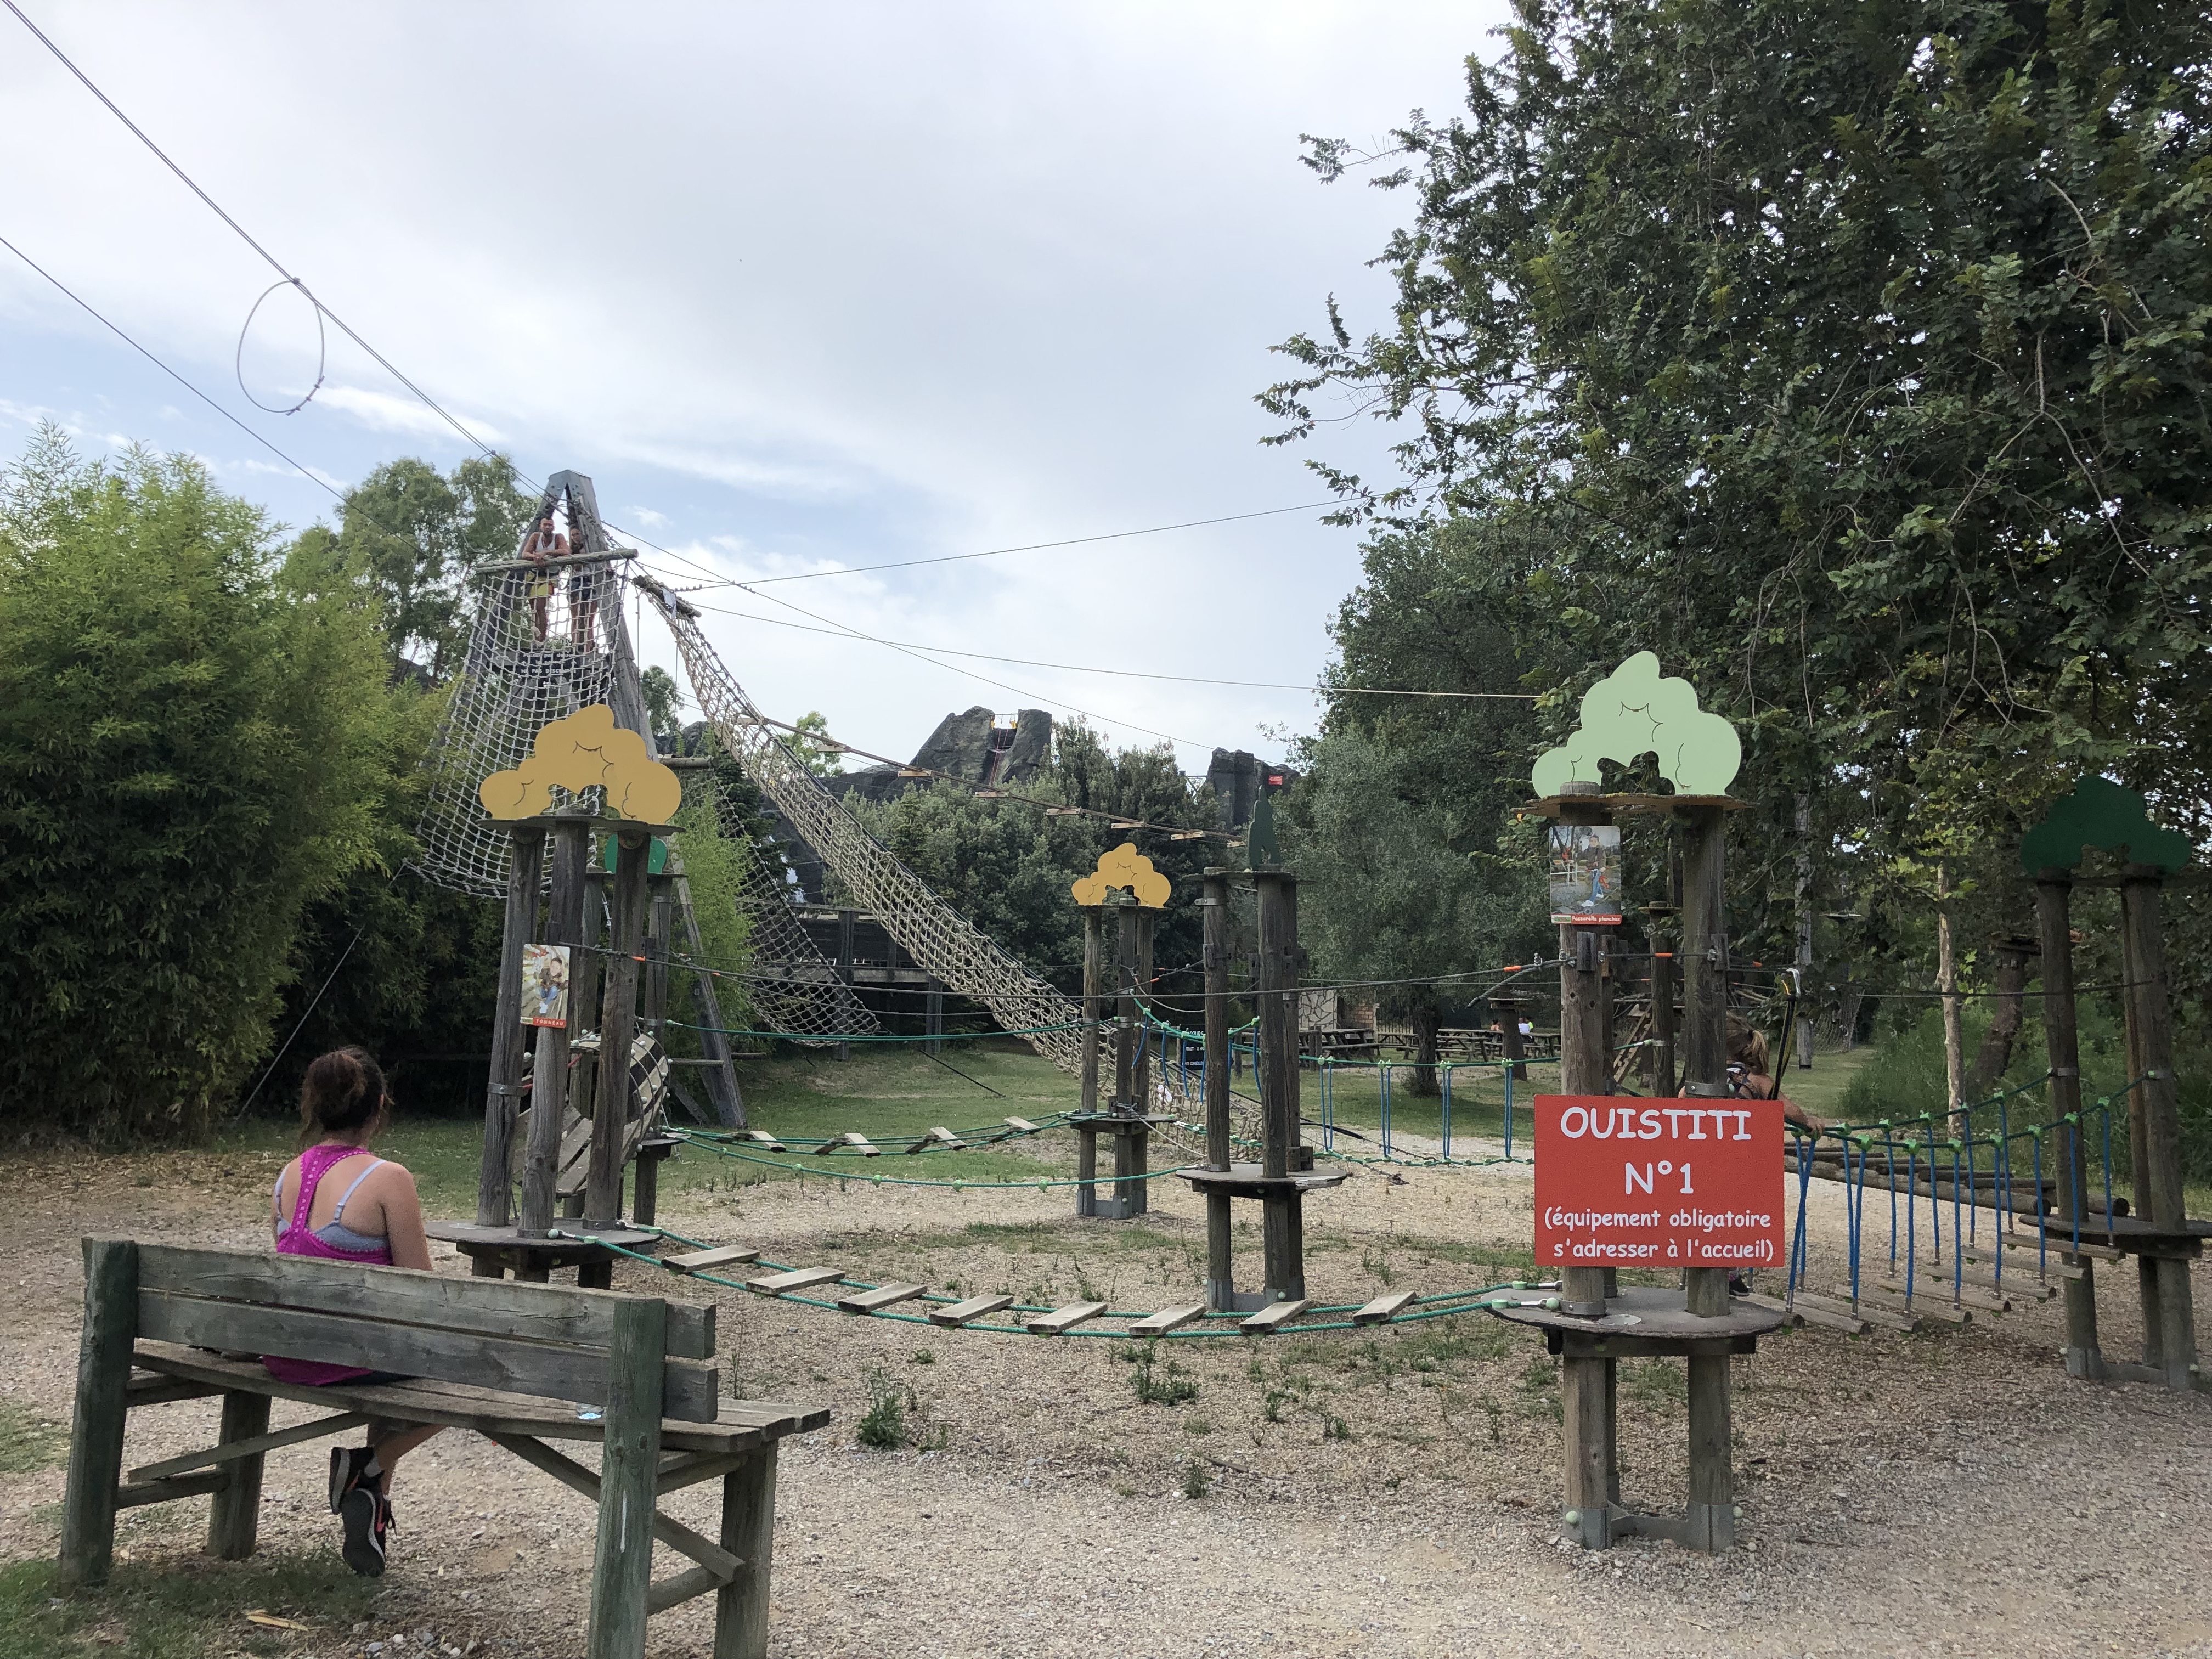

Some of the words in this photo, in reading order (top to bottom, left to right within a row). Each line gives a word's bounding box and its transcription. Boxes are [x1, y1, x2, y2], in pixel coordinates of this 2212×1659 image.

[1560, 1107, 1752, 1141] OUISTITI
[1625, 1160, 1694, 1195] N°1
[1545, 1206, 1661, 1232] (équipement
[1669, 1208, 1771, 1233] obligatoire
[1554, 1238, 1659, 1258] s'adresser
[1667, 1238, 1679, 1258] à
[1687, 1239, 1774, 1262] l'accueil)
